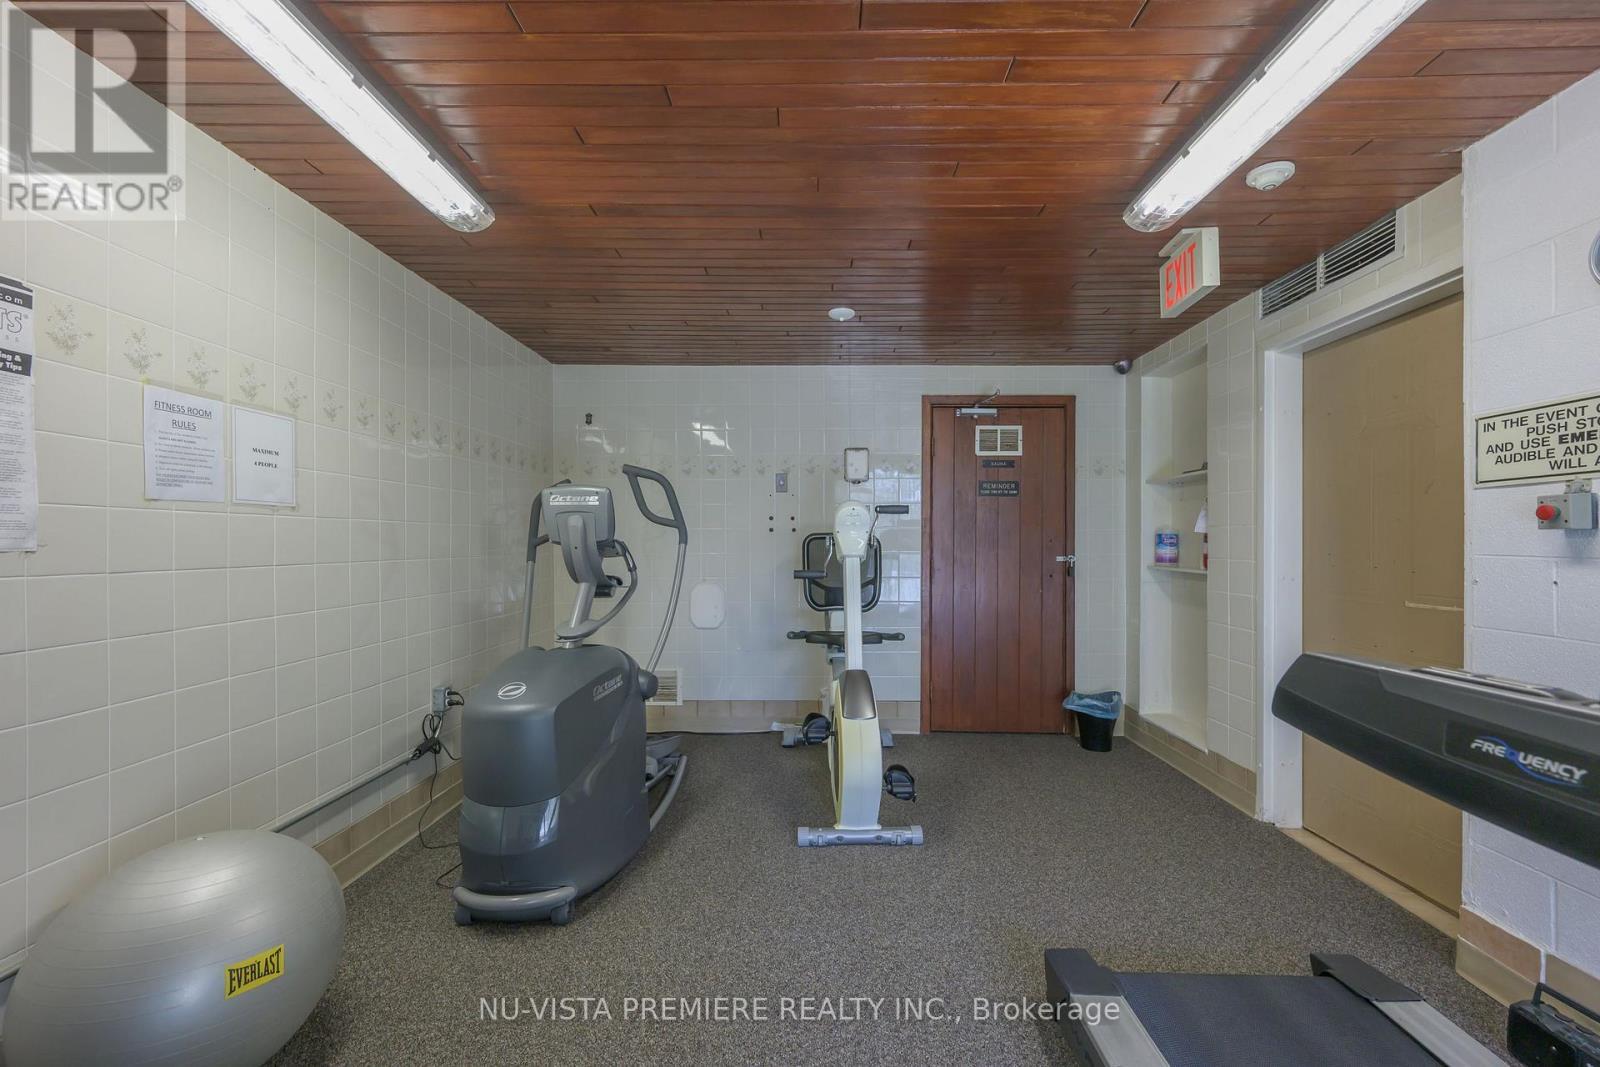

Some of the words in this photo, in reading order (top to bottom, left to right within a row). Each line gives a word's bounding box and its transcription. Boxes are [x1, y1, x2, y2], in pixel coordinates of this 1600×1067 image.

[1164, 242, 1197, 310] EXIT
[154, 400, 186, 414] FITNESS
[187, 406, 212, 418] ROOM
[171, 419, 197, 431] RULES
[1483, 421, 1496, 432] IN
[1501, 416, 1528, 429] THE
[1536, 405, 1589, 424] EVENT
[1526, 421, 1568, 437] PUSH
[252, 447, 280, 456] MAXIMUM
[1486, 441, 1514, 455] AND
[1520, 436, 1551, 450] USE
[1494, 448, 1556, 465] AUDIBLE
[1563, 443, 1598, 457] AND
[258, 461, 278, 469] PEOPLE
[1548, 457, 1587, 471] WILL
[1470, 738, 1589, 781] FREQUENCY
[228, 947, 282, 996] EVERLAST
